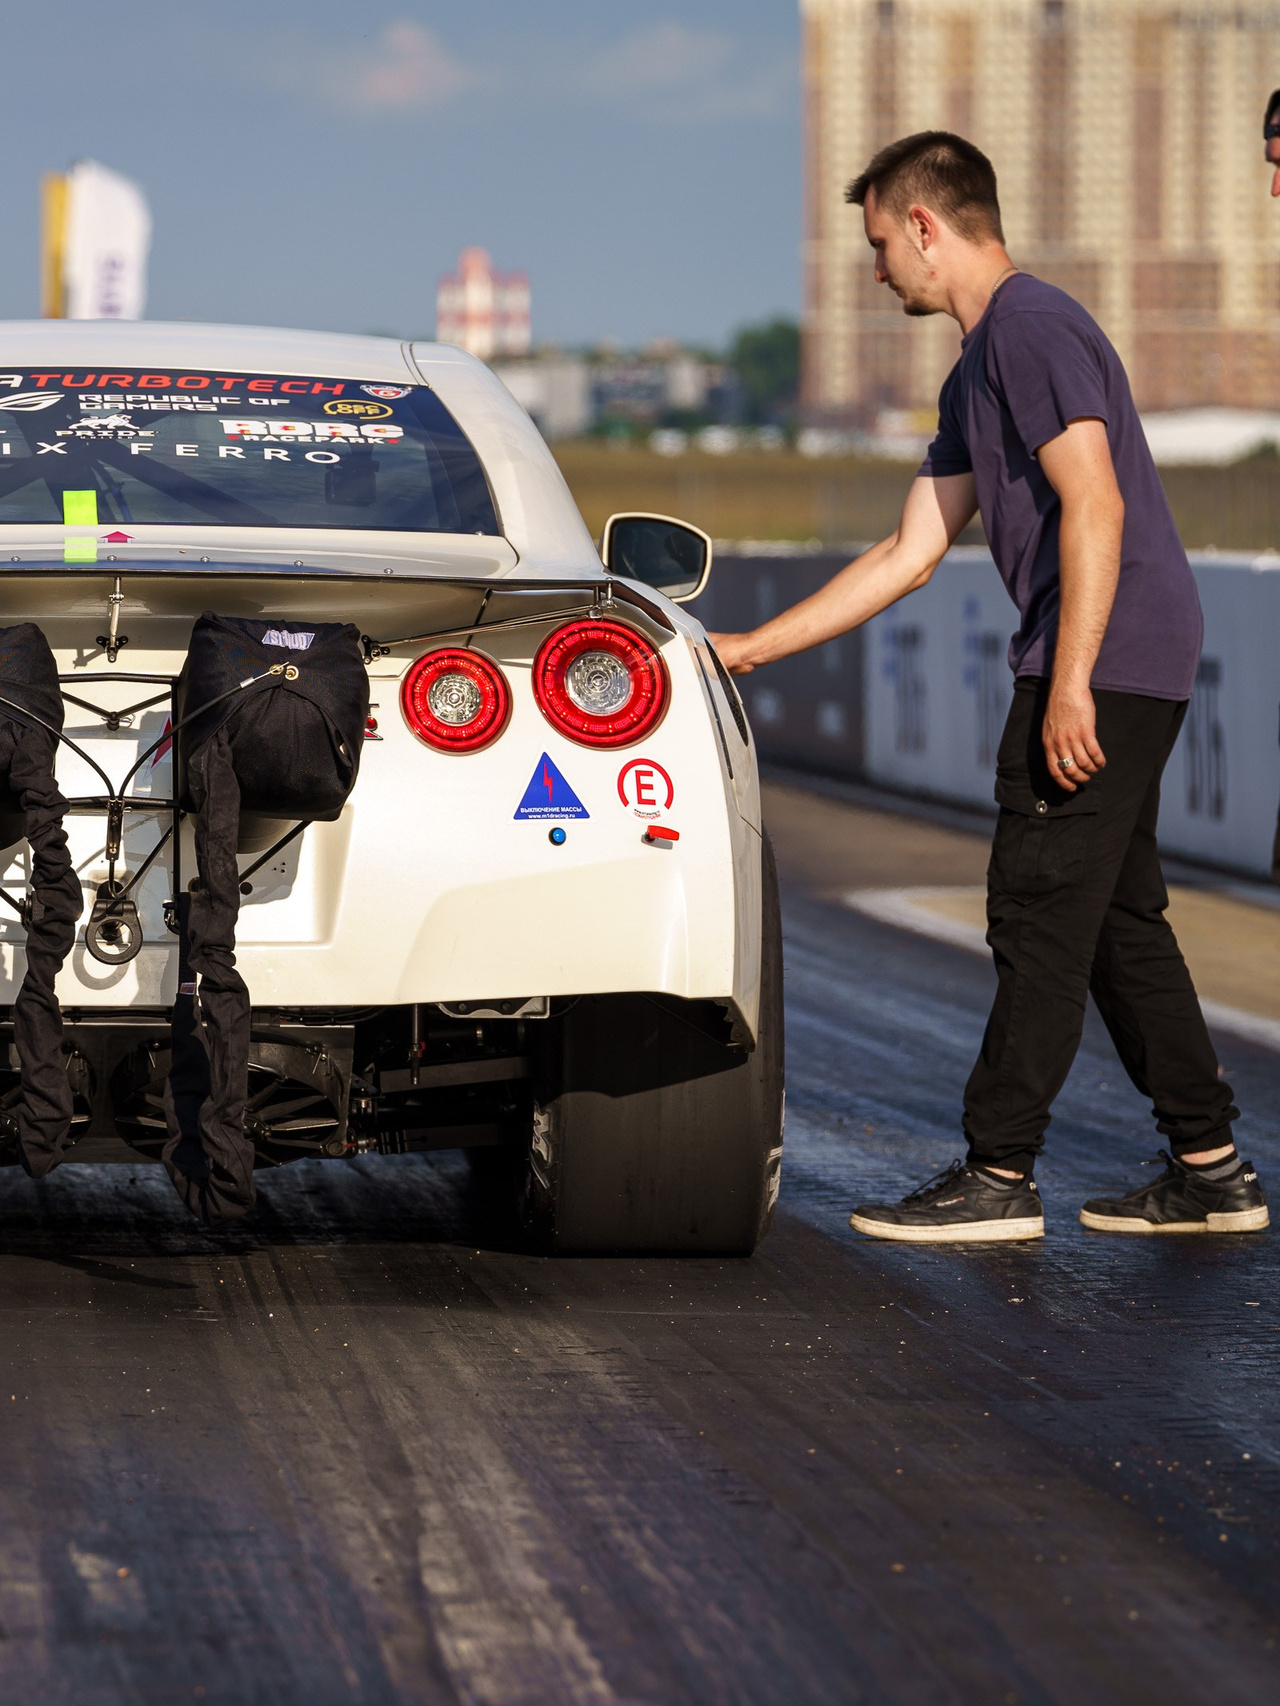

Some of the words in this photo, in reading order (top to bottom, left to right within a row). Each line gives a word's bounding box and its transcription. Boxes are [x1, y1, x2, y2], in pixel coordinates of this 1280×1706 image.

[78, 394, 241, 404] REPUBLIC
[248, 397, 291, 406] OF
[79, 402, 218, 412] GAMERS
[243, 434, 385, 444] RACEPARK
[130, 442, 341, 464] FERRO
[635, 769, 656, 806] E
